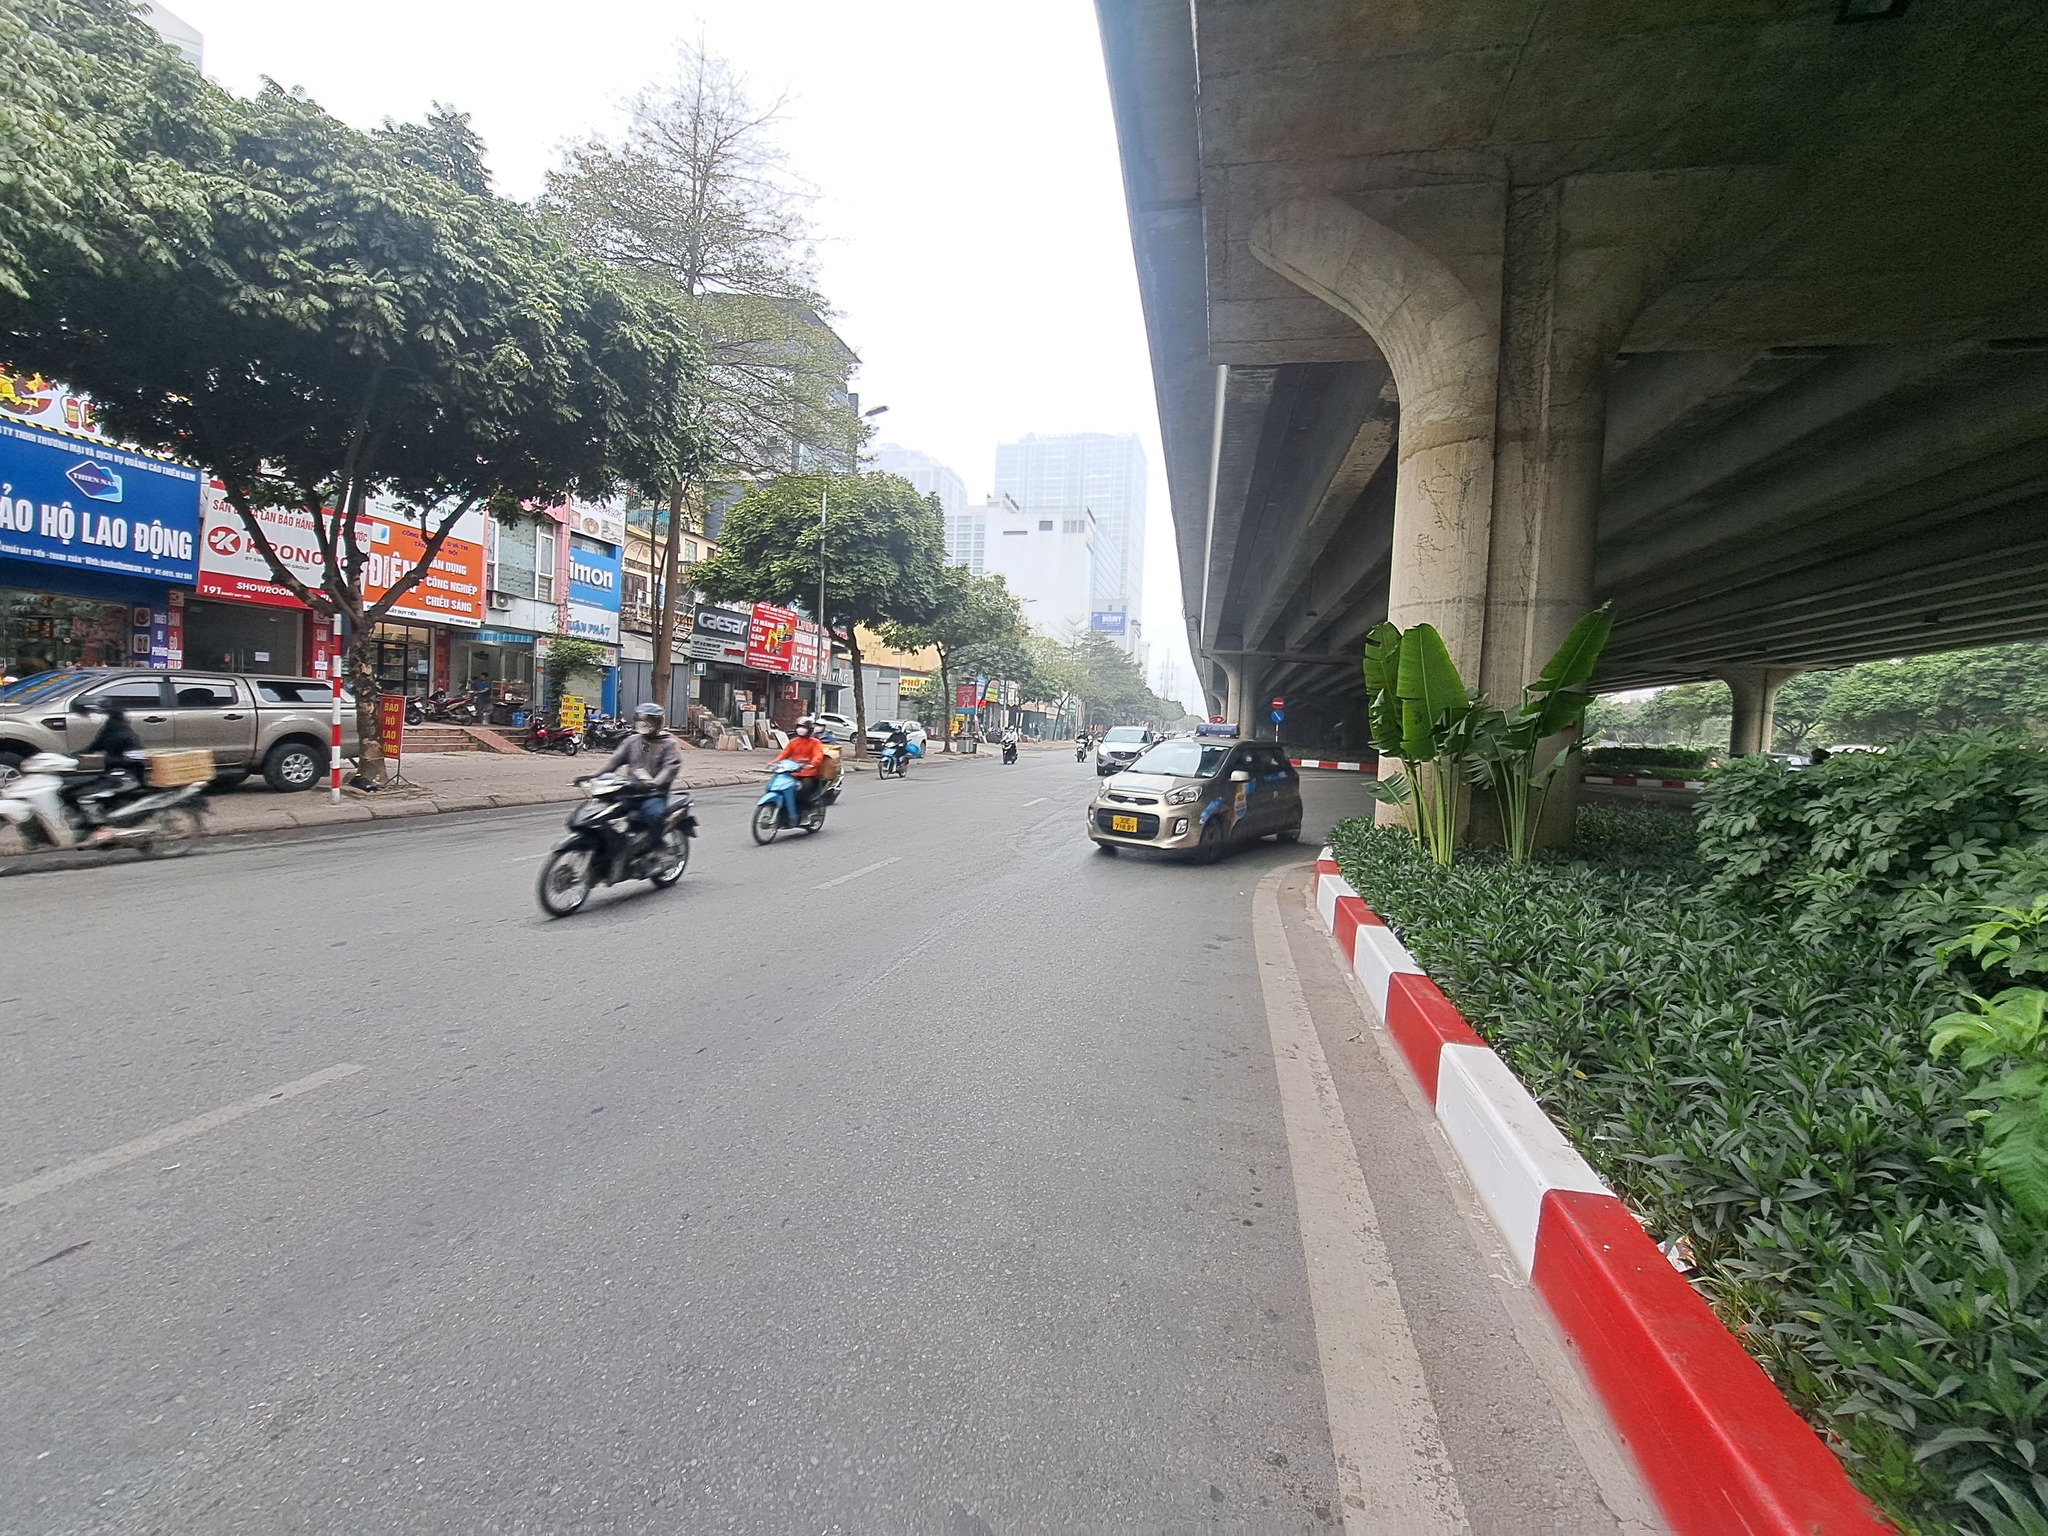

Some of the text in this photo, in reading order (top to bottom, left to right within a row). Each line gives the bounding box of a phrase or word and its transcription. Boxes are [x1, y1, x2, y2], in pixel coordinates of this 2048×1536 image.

[41, 501, 76, 546] HỘ
[82, 512, 128, 549] LAO
[134, 520, 193, 560] ĐỘNG
[445, 562, 468, 576] DỤNG
[569, 555, 613, 589] imon
[202, 585, 221, 595] 191
[426, 575, 478, 597] CÔNG NGHIỆP
[425, 593, 472, 613] CHIẾU SÁNG
[901, 678, 920, 687] PHỞ
[384, 700, 399, 712] BẢO
[382, 730, 396, 740] LAO
